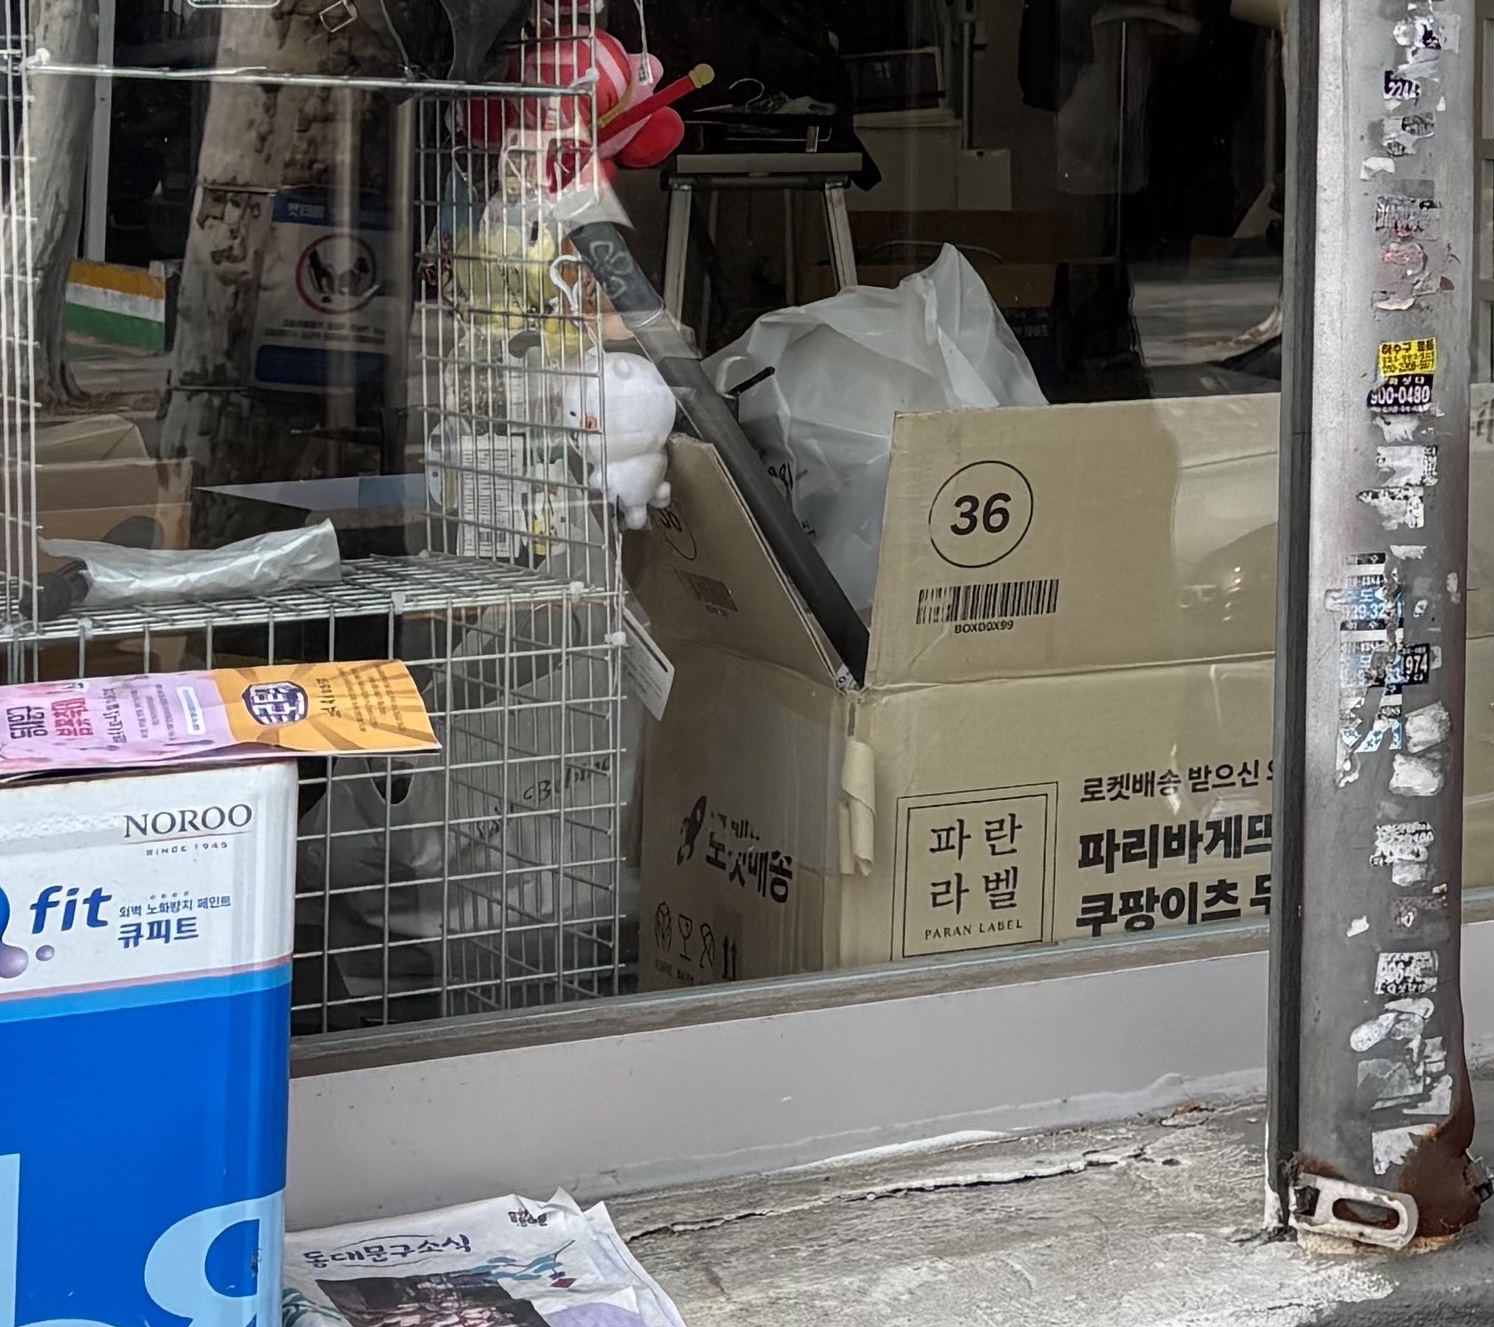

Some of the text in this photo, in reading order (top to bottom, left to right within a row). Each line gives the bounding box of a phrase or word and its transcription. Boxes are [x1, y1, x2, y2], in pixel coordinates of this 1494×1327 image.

[950, 492, 1012, 536] 36
[1080, 769, 1182, 803] 로켓배송
[1188, 759, 1260, 793] 받으신
[124, 804, 253, 838] NOROO
[146, 841, 228, 856] SINCE 1945
[29, 885, 112, 934] fit
[146, 898, 193, 915] 노화방지
[197, 895, 231, 909] 페인트
[1076, 878, 1242, 938] 쿠팡이츠
[118, 916, 200, 949] 큐피트
[925, 919, 1023, 940] PARAN LABEL
[302, 1233, 471, 1268] 동대문구소식
